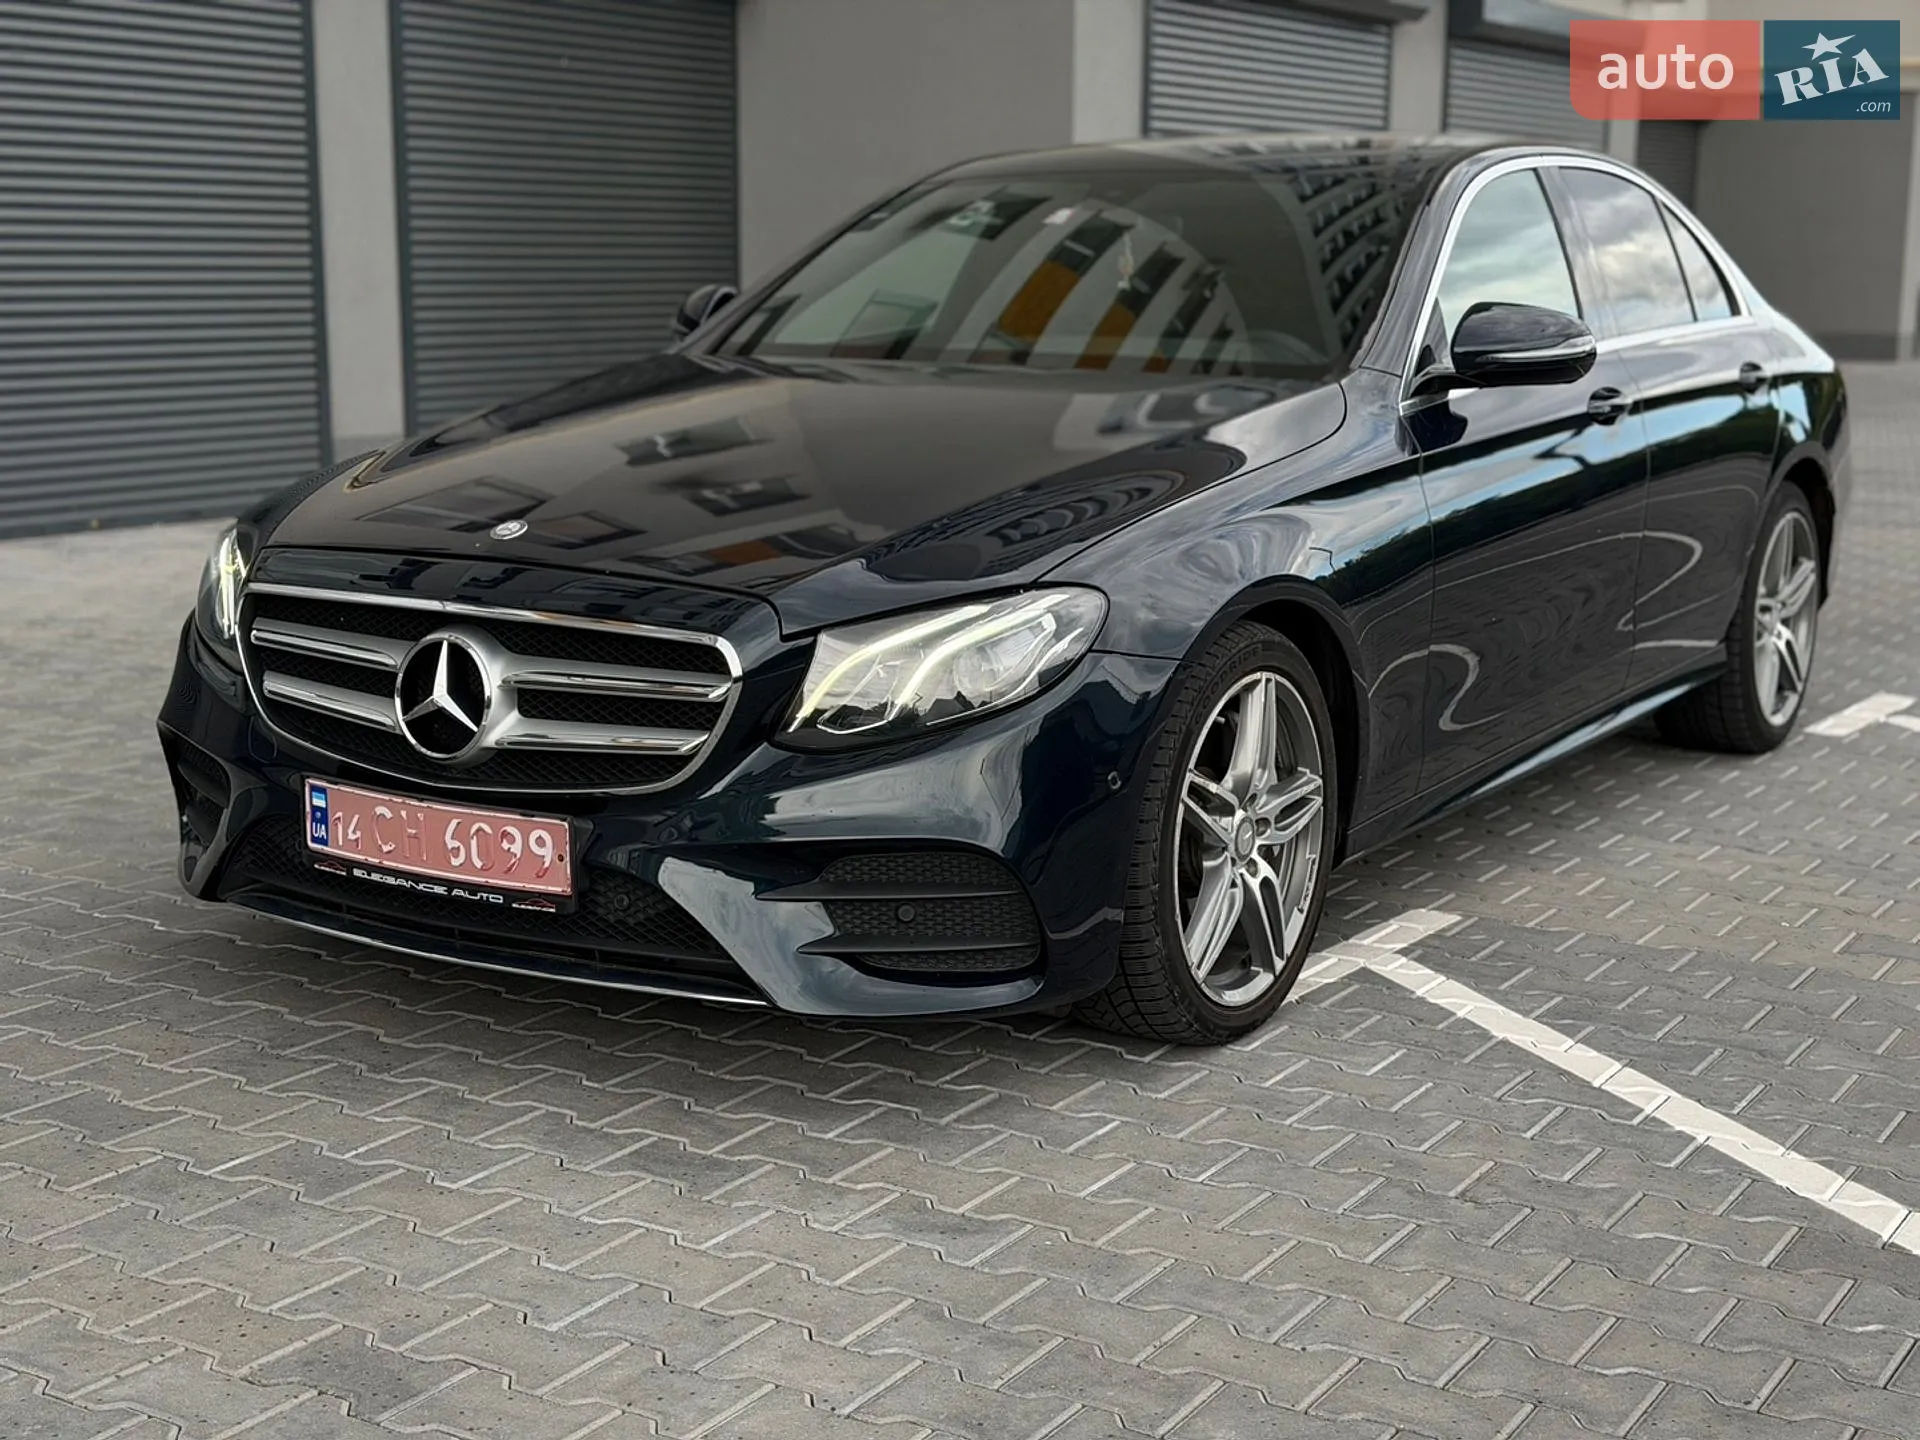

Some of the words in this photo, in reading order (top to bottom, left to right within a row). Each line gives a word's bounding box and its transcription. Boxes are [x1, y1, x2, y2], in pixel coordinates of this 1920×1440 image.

[1194, 645, 1262, 724] GOODRIDE
[311, 821, 327, 840] UA
[331, 810, 362, 851] 14
[443, 817, 555, 879] 6099
[352, 867, 449, 895] ELEGANCE
[451, 888, 504, 904] AUTO
